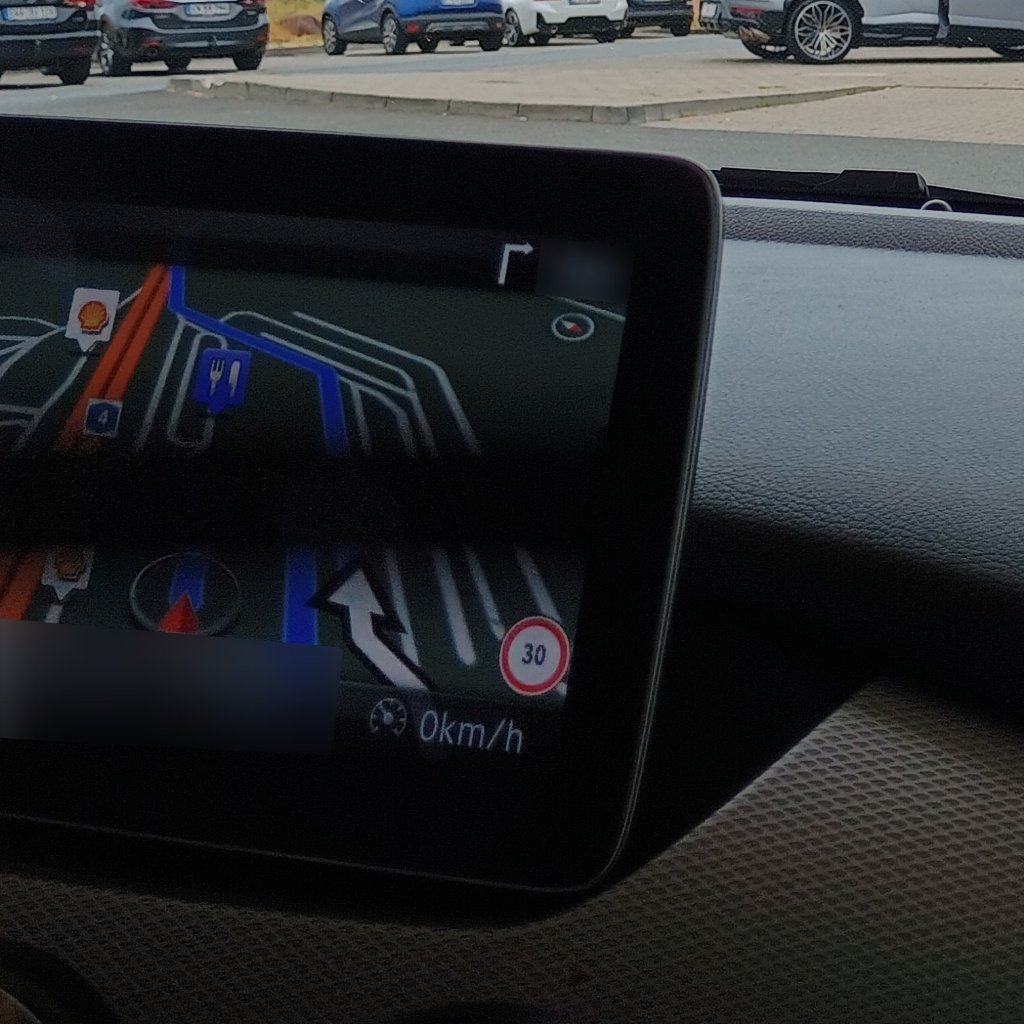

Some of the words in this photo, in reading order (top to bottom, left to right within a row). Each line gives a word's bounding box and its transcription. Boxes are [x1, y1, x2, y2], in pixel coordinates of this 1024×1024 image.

[98, 409, 109, 425] 4
[521, 643, 546, 665] 30
[419, 709, 523, 754] 0km/h
